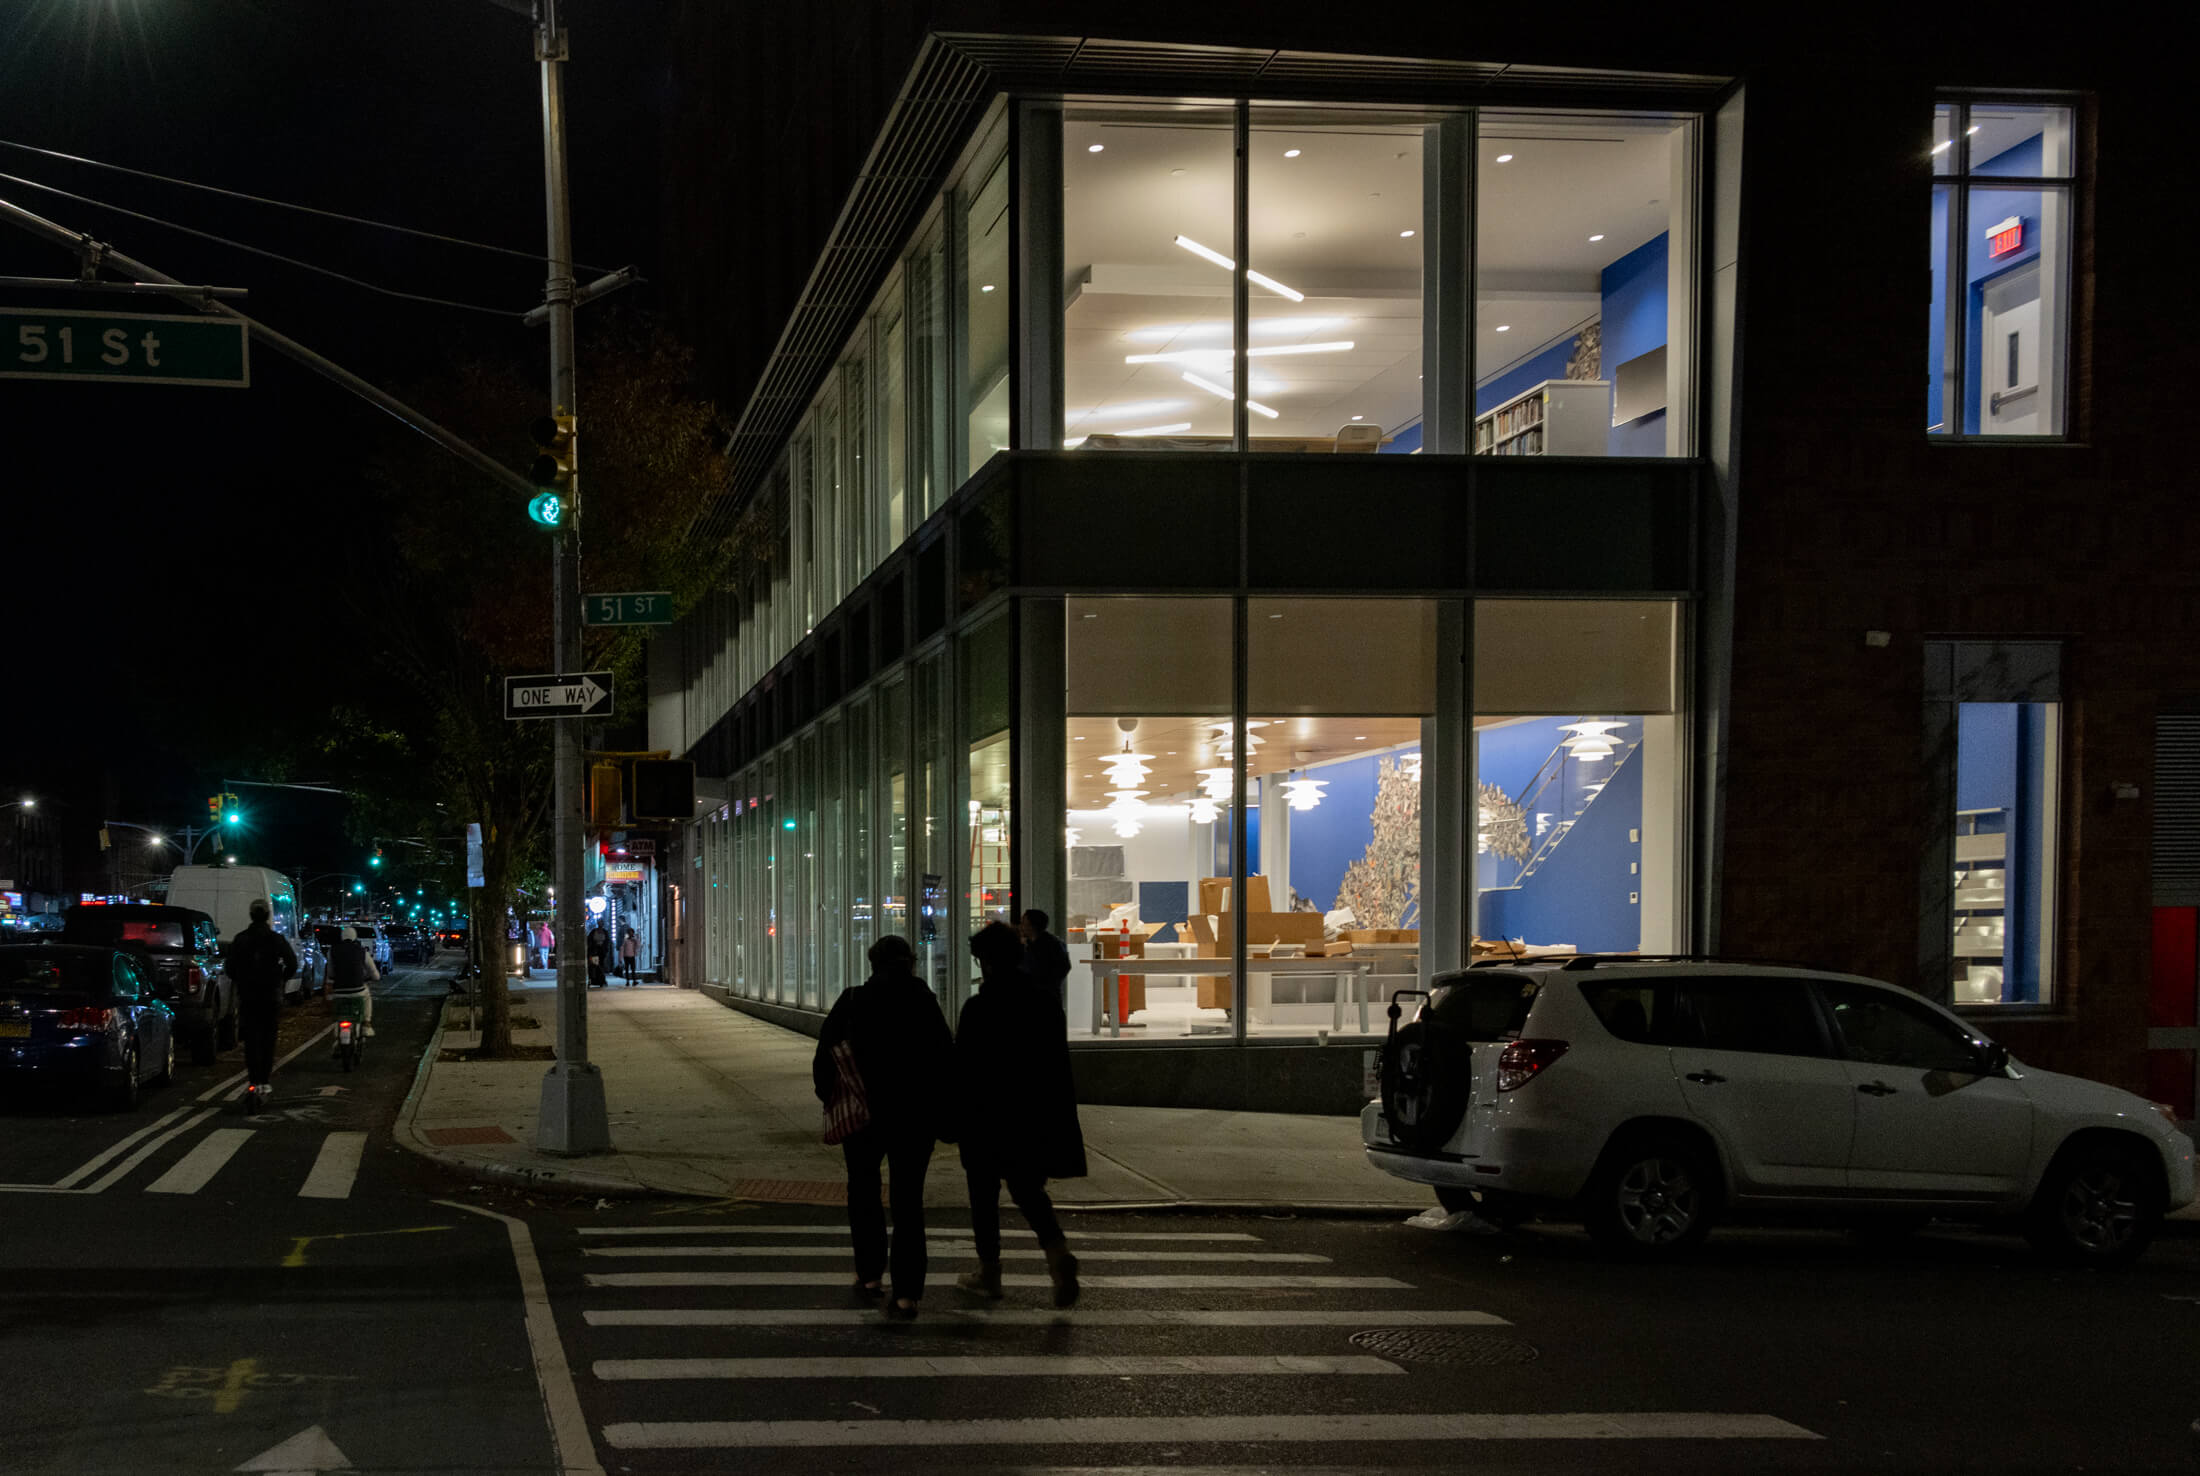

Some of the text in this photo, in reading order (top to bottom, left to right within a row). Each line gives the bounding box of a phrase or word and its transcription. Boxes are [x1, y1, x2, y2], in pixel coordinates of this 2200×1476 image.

[18, 324, 161, 367] 51 St
[600, 596, 656, 622] 51 ST
[521, 686, 597, 706] ONE WAY
[632, 840, 654, 850] ATM
